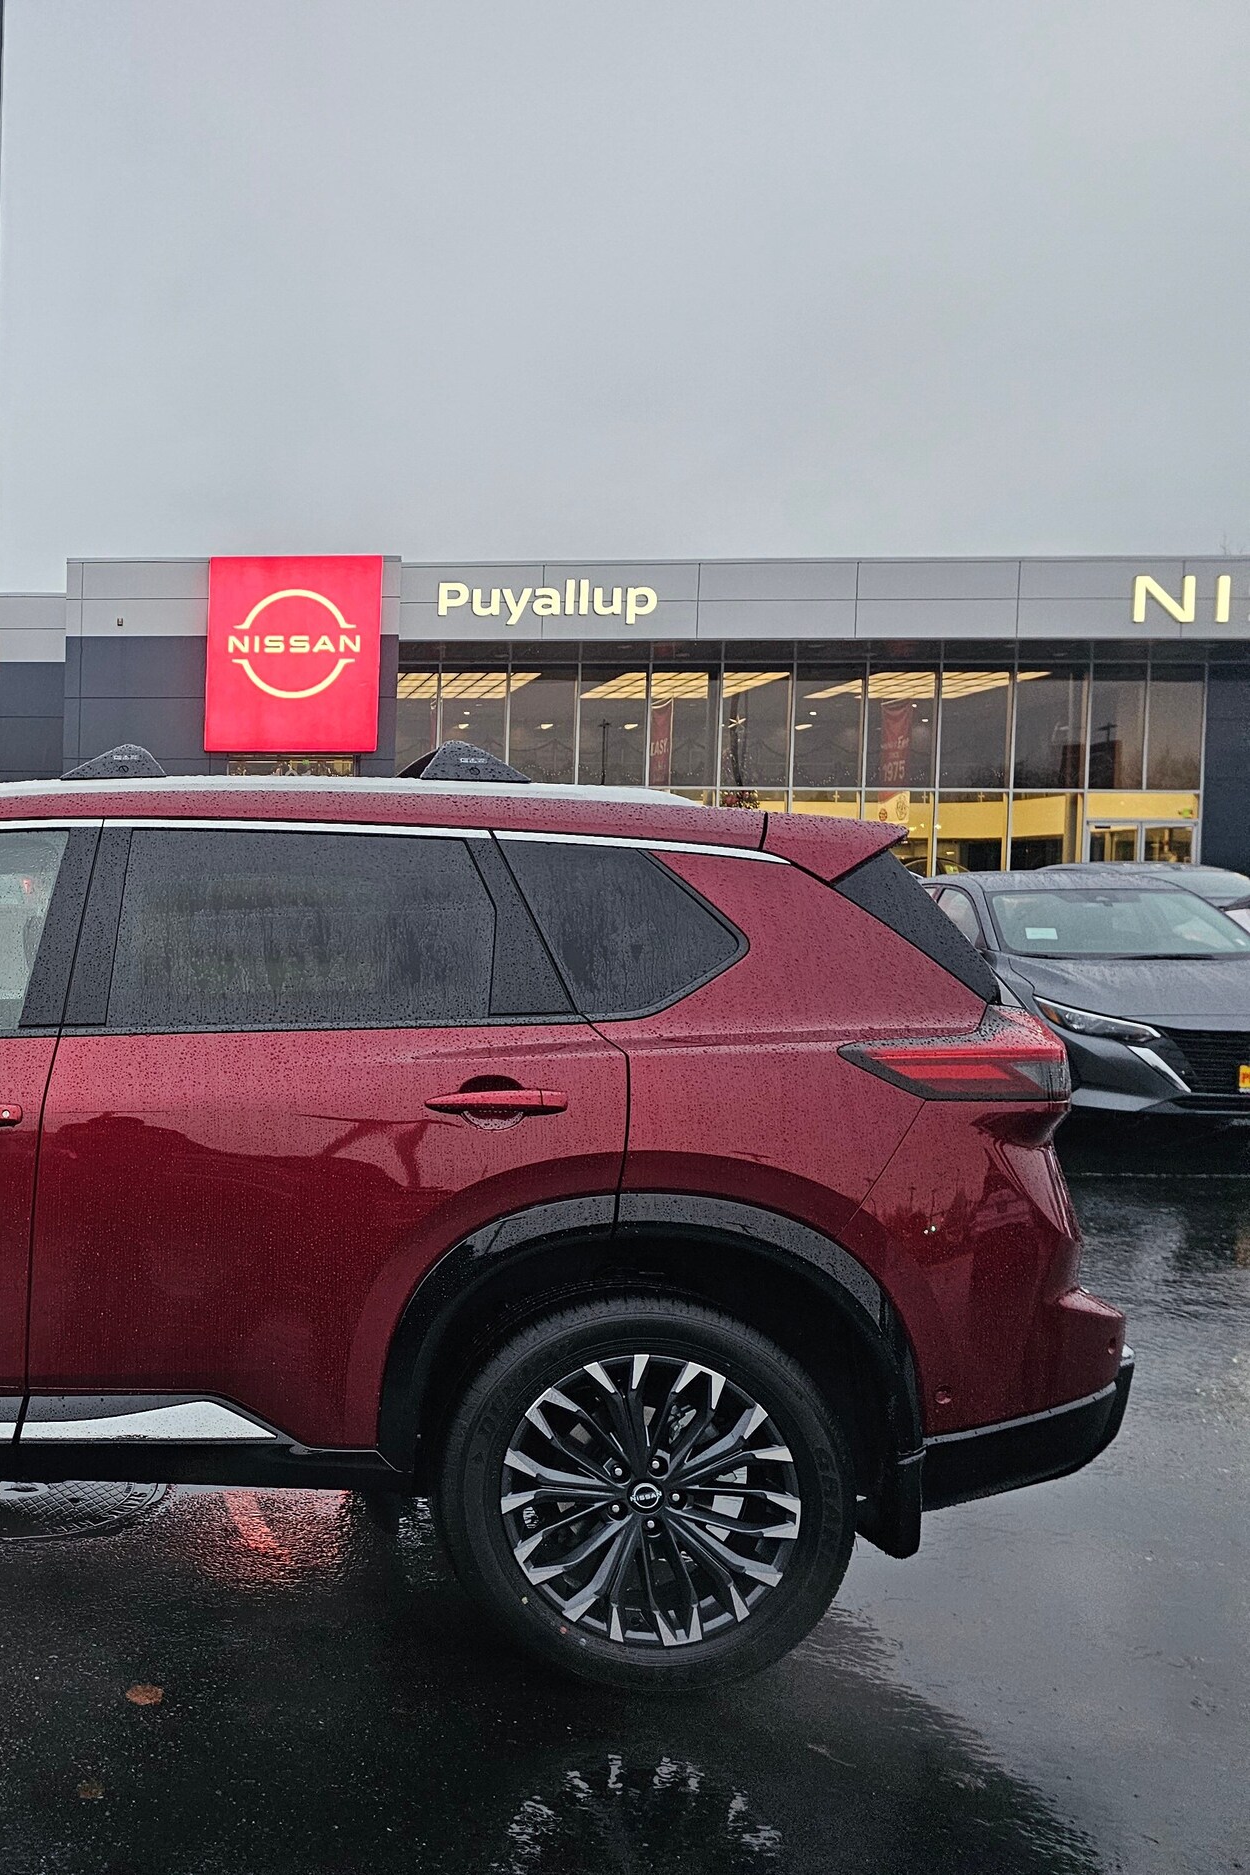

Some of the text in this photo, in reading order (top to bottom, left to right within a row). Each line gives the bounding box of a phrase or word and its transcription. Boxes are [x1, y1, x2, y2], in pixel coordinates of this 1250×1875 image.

[437, 579, 659, 625] Puyallup
[1133, 575, 1250, 623] NI
[227, 634, 361, 654] NISSAN
[883, 760, 906, 782] 1975
[630, 1490, 662, 1501] NISSAN
